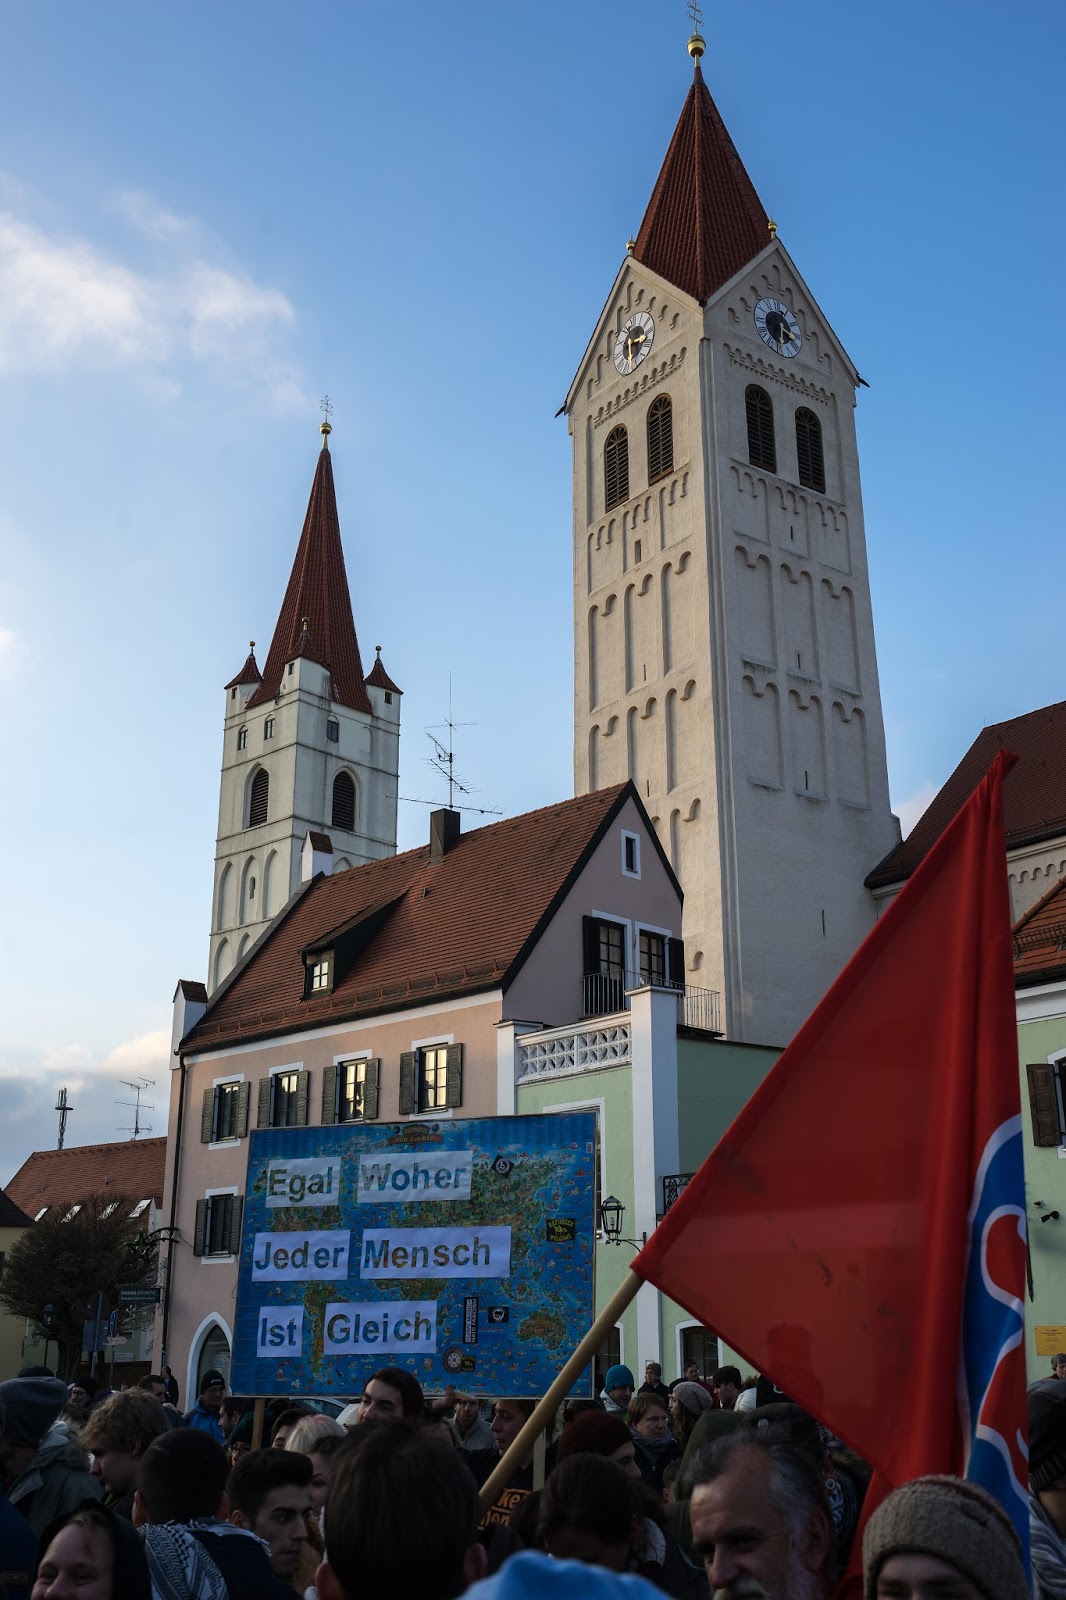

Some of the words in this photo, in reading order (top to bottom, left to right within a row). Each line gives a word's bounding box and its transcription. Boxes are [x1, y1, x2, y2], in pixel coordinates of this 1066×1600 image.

[268, 1166, 333, 1203] Egal
[361, 1162, 467, 1191] Woher
[255, 1241, 345, 1270] Jeder
[364, 1237, 491, 1269] Mensch
[260, 1317, 297, 1347] Ist
[327, 1311, 431, 1344] Gleich
